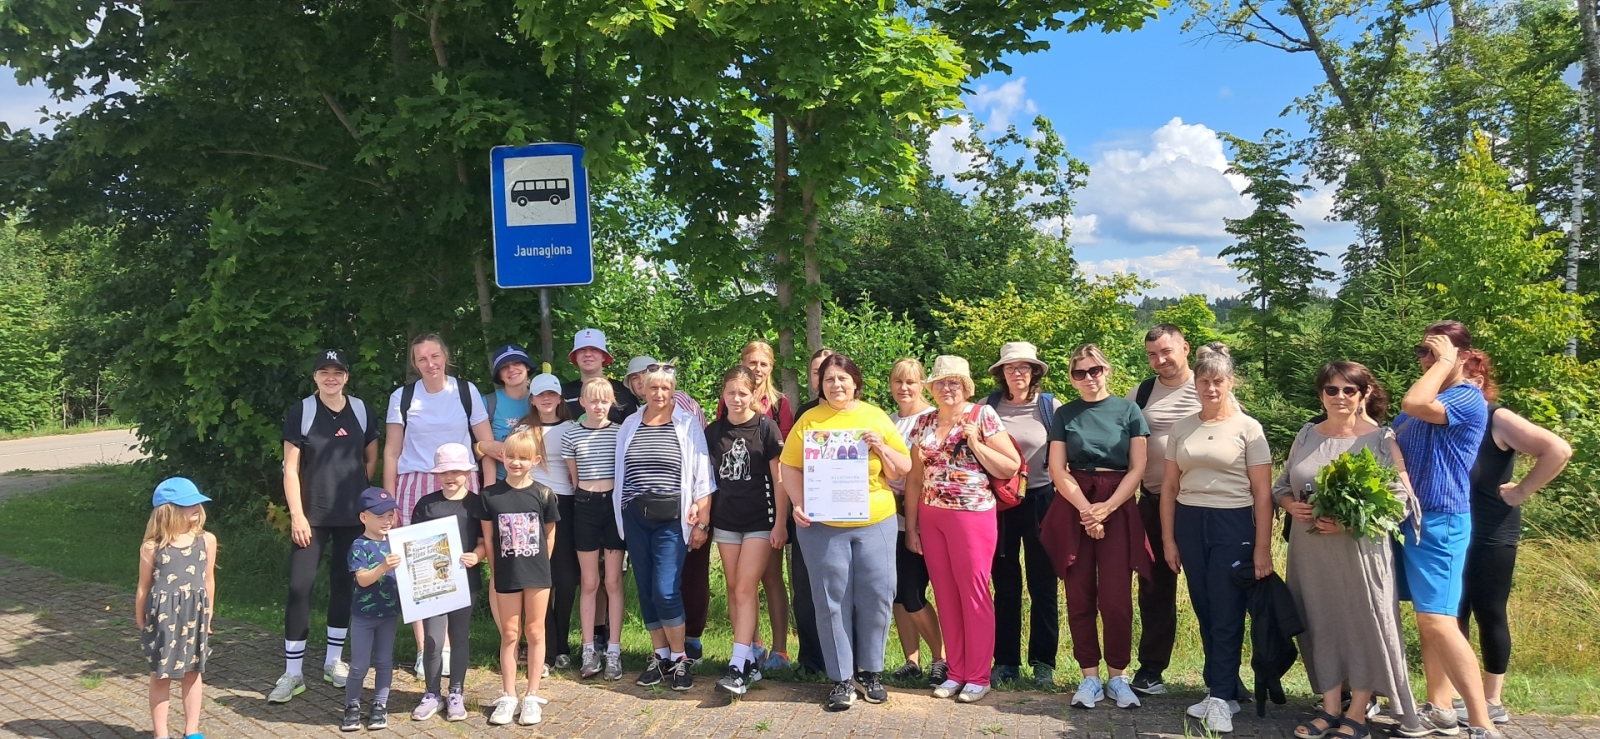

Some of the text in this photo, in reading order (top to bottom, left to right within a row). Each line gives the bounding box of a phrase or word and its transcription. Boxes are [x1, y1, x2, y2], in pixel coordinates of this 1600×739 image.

[513, 243, 573, 259] Jaunaglona
[326, 350, 338, 361] NY
[501, 548, 540, 558] K-POP
